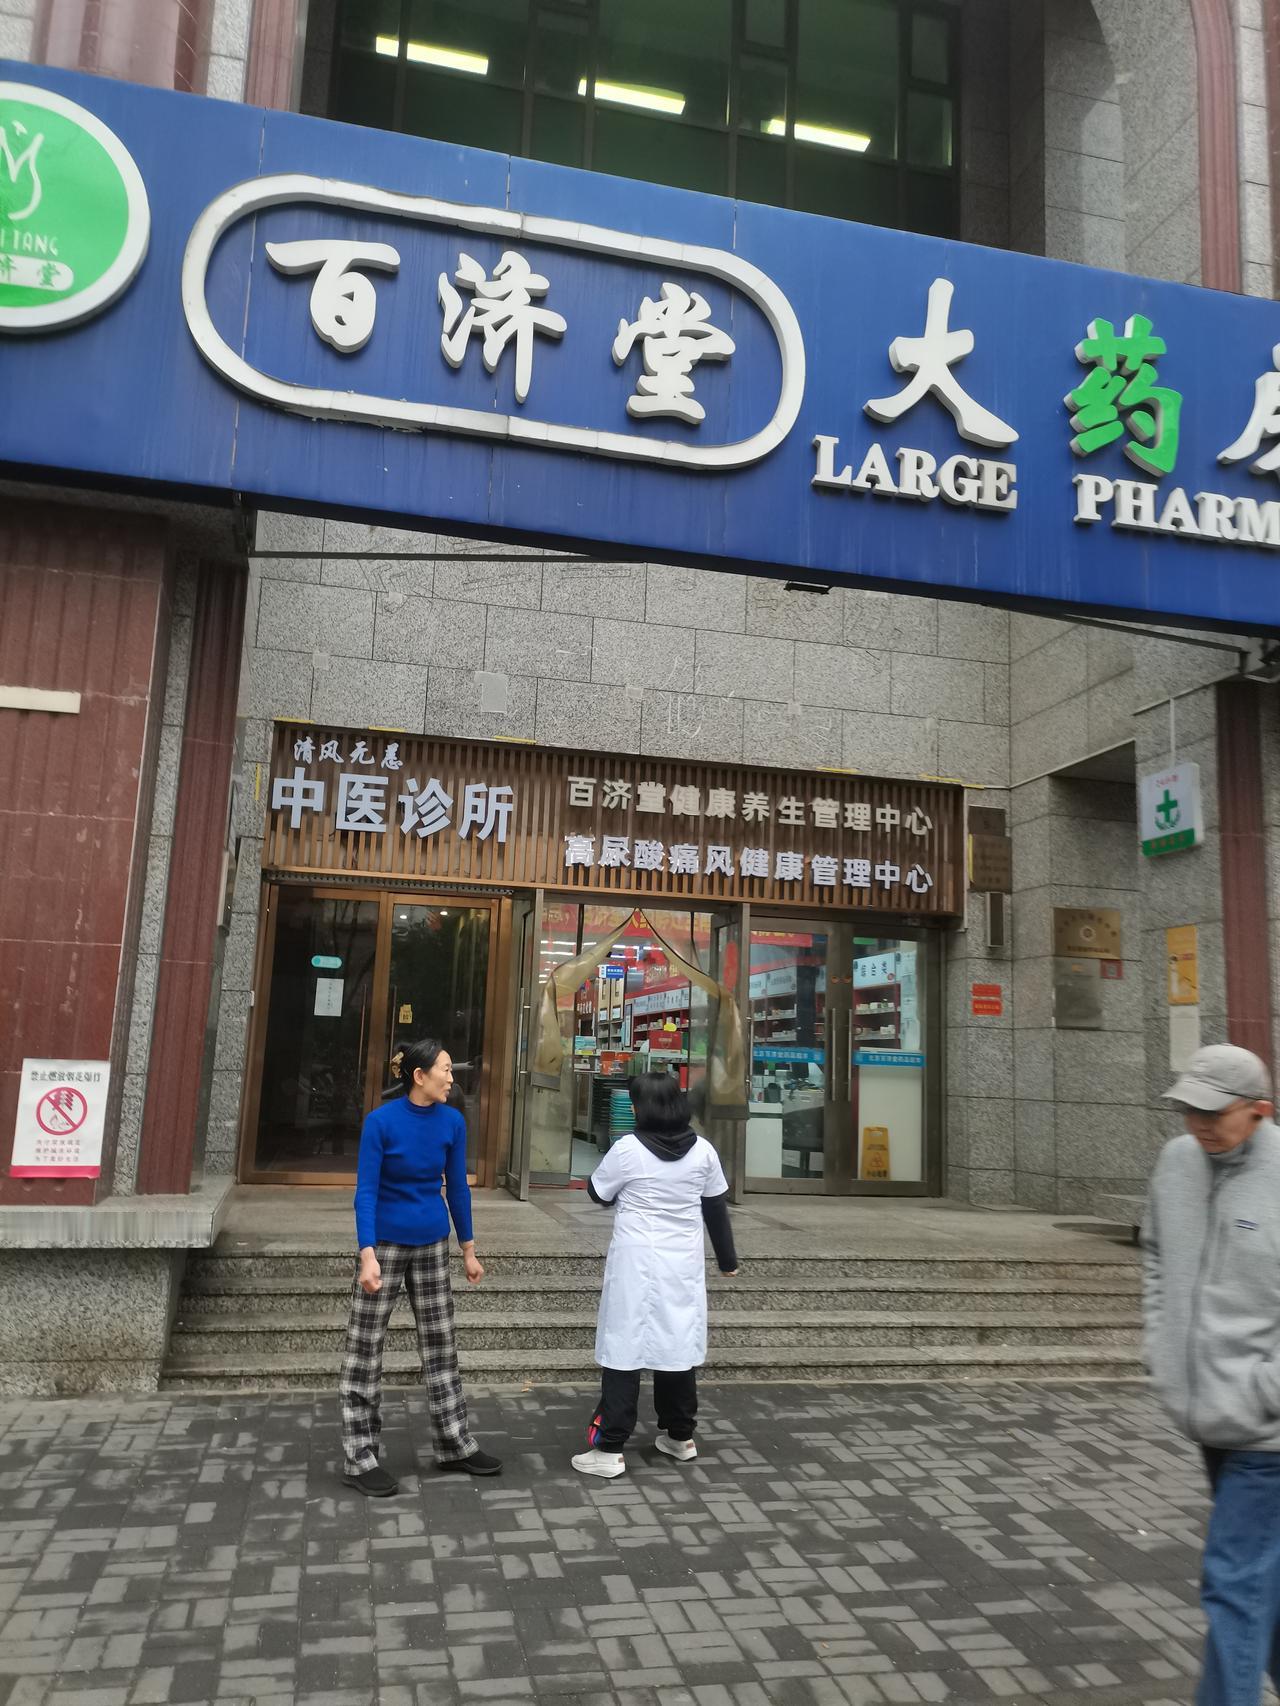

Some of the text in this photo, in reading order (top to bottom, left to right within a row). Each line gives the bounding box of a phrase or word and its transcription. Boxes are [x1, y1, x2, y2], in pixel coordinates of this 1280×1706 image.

[265, 239, 736, 424] 百济堂
[811, 435, 1280, 550] LARGE PHARM
[271, 766, 514, 843] 中医诊所
[567, 776, 933, 836] 百济堂健康养生管理中心
[564, 834, 933, 894] 高尿酸痛风健康管理中心
